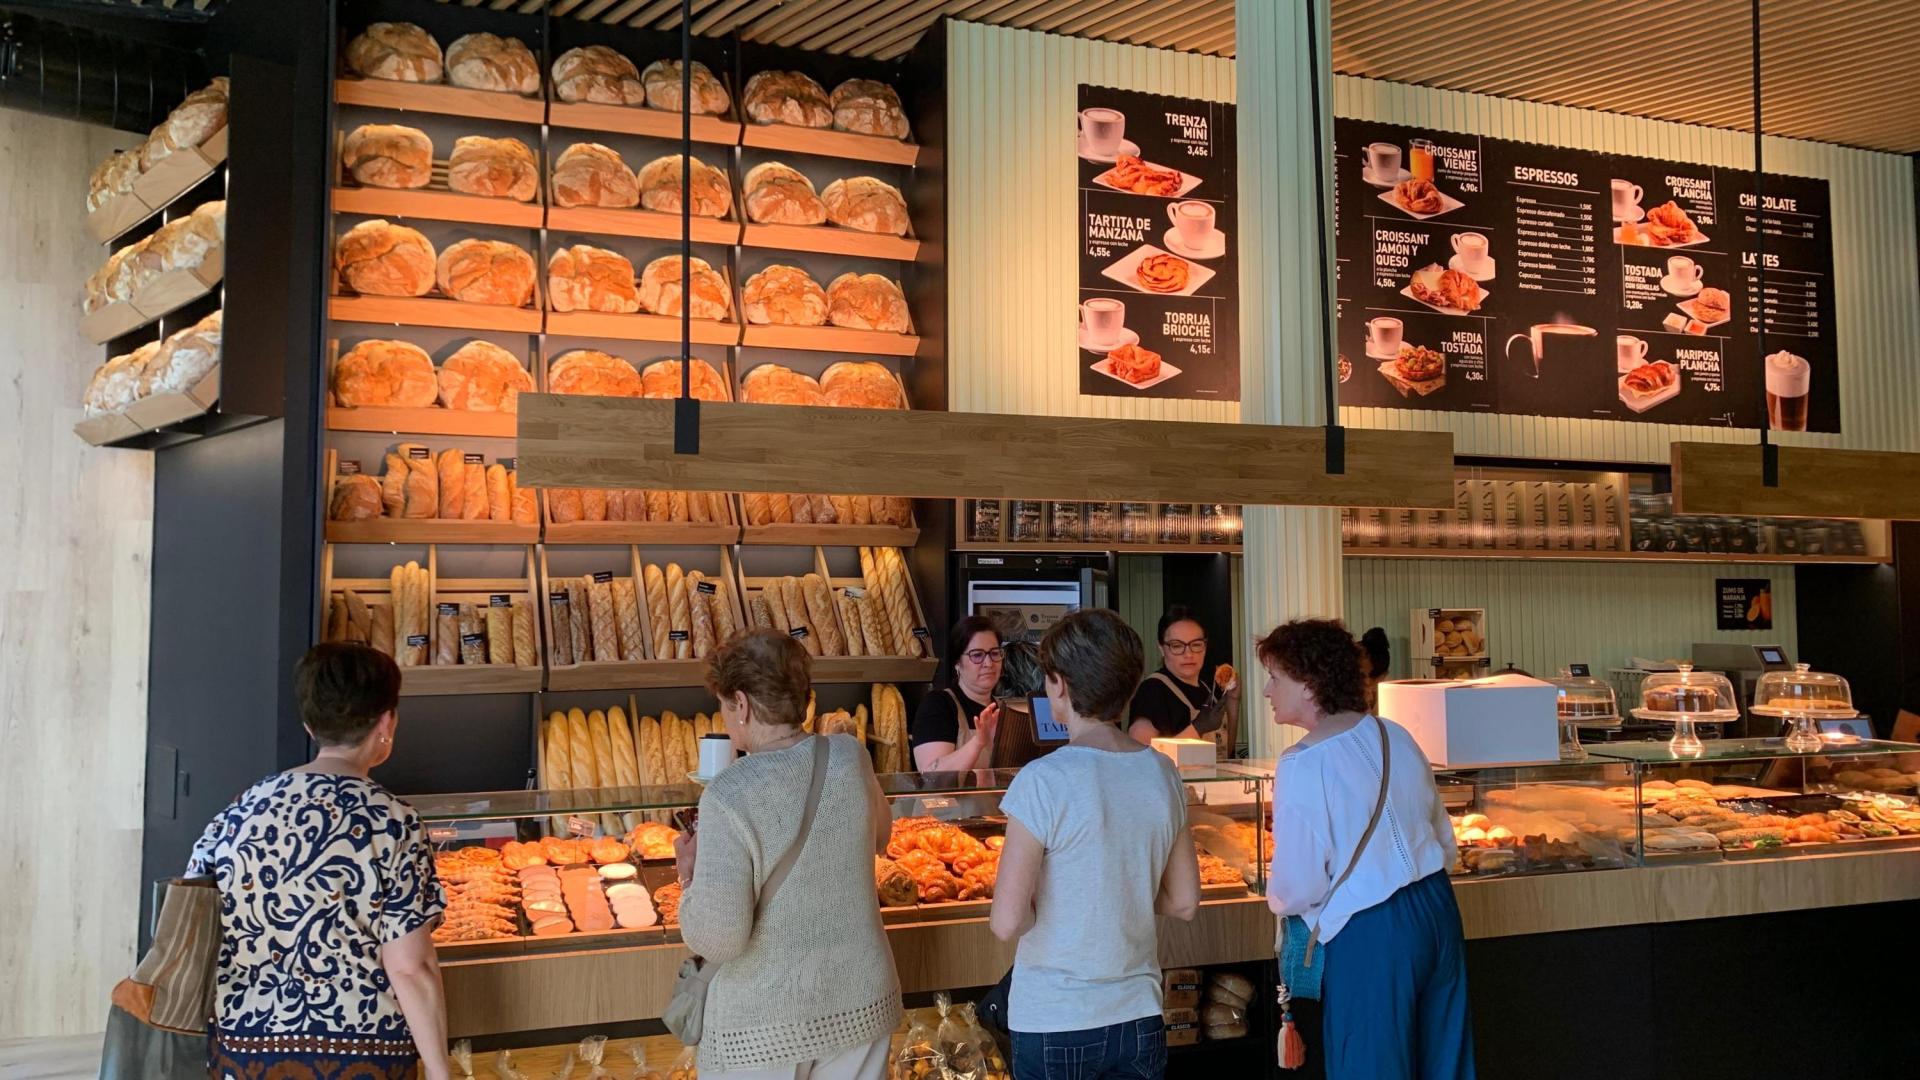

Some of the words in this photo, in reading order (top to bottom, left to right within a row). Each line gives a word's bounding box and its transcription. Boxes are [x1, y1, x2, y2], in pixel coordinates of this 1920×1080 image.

[1165, 113, 1208, 128] TRENZA
[1183, 127, 1207, 140] MINI
[1424, 144, 1477, 160] CROISSANT
[1514, 166, 1579, 186] ESPRESSOS
[1665, 175, 1711, 190] CROISSANT
[1673, 187, 1712, 200] PLANCHA
[1089, 214, 1138, 228] TARTITA
[1138, 218, 1151, 231] DE
[1089, 226, 1144, 242] MANZANA
[1376, 230, 1429, 245] CROISSANT
[1376, 241, 1410, 256] JAMÓN
[1412, 246, 1418, 256] Y
[1376, 254, 1408, 268] QUESO
[1742, 252, 1779, 267] LATES
[1625, 264, 1662, 277] TOSTADA
[1165, 312, 1210, 326] TORRIJA
[1163, 324, 1210, 338] BRIOCHE
[1453, 331, 1482, 344] MEDIA
[1441, 342, 1483, 355] TOSTADA
[1676, 349, 1719, 362] MARIPOSA
[1680, 360, 1720, 372] PLANCHA
[1041, 722, 1068, 732] TAB
